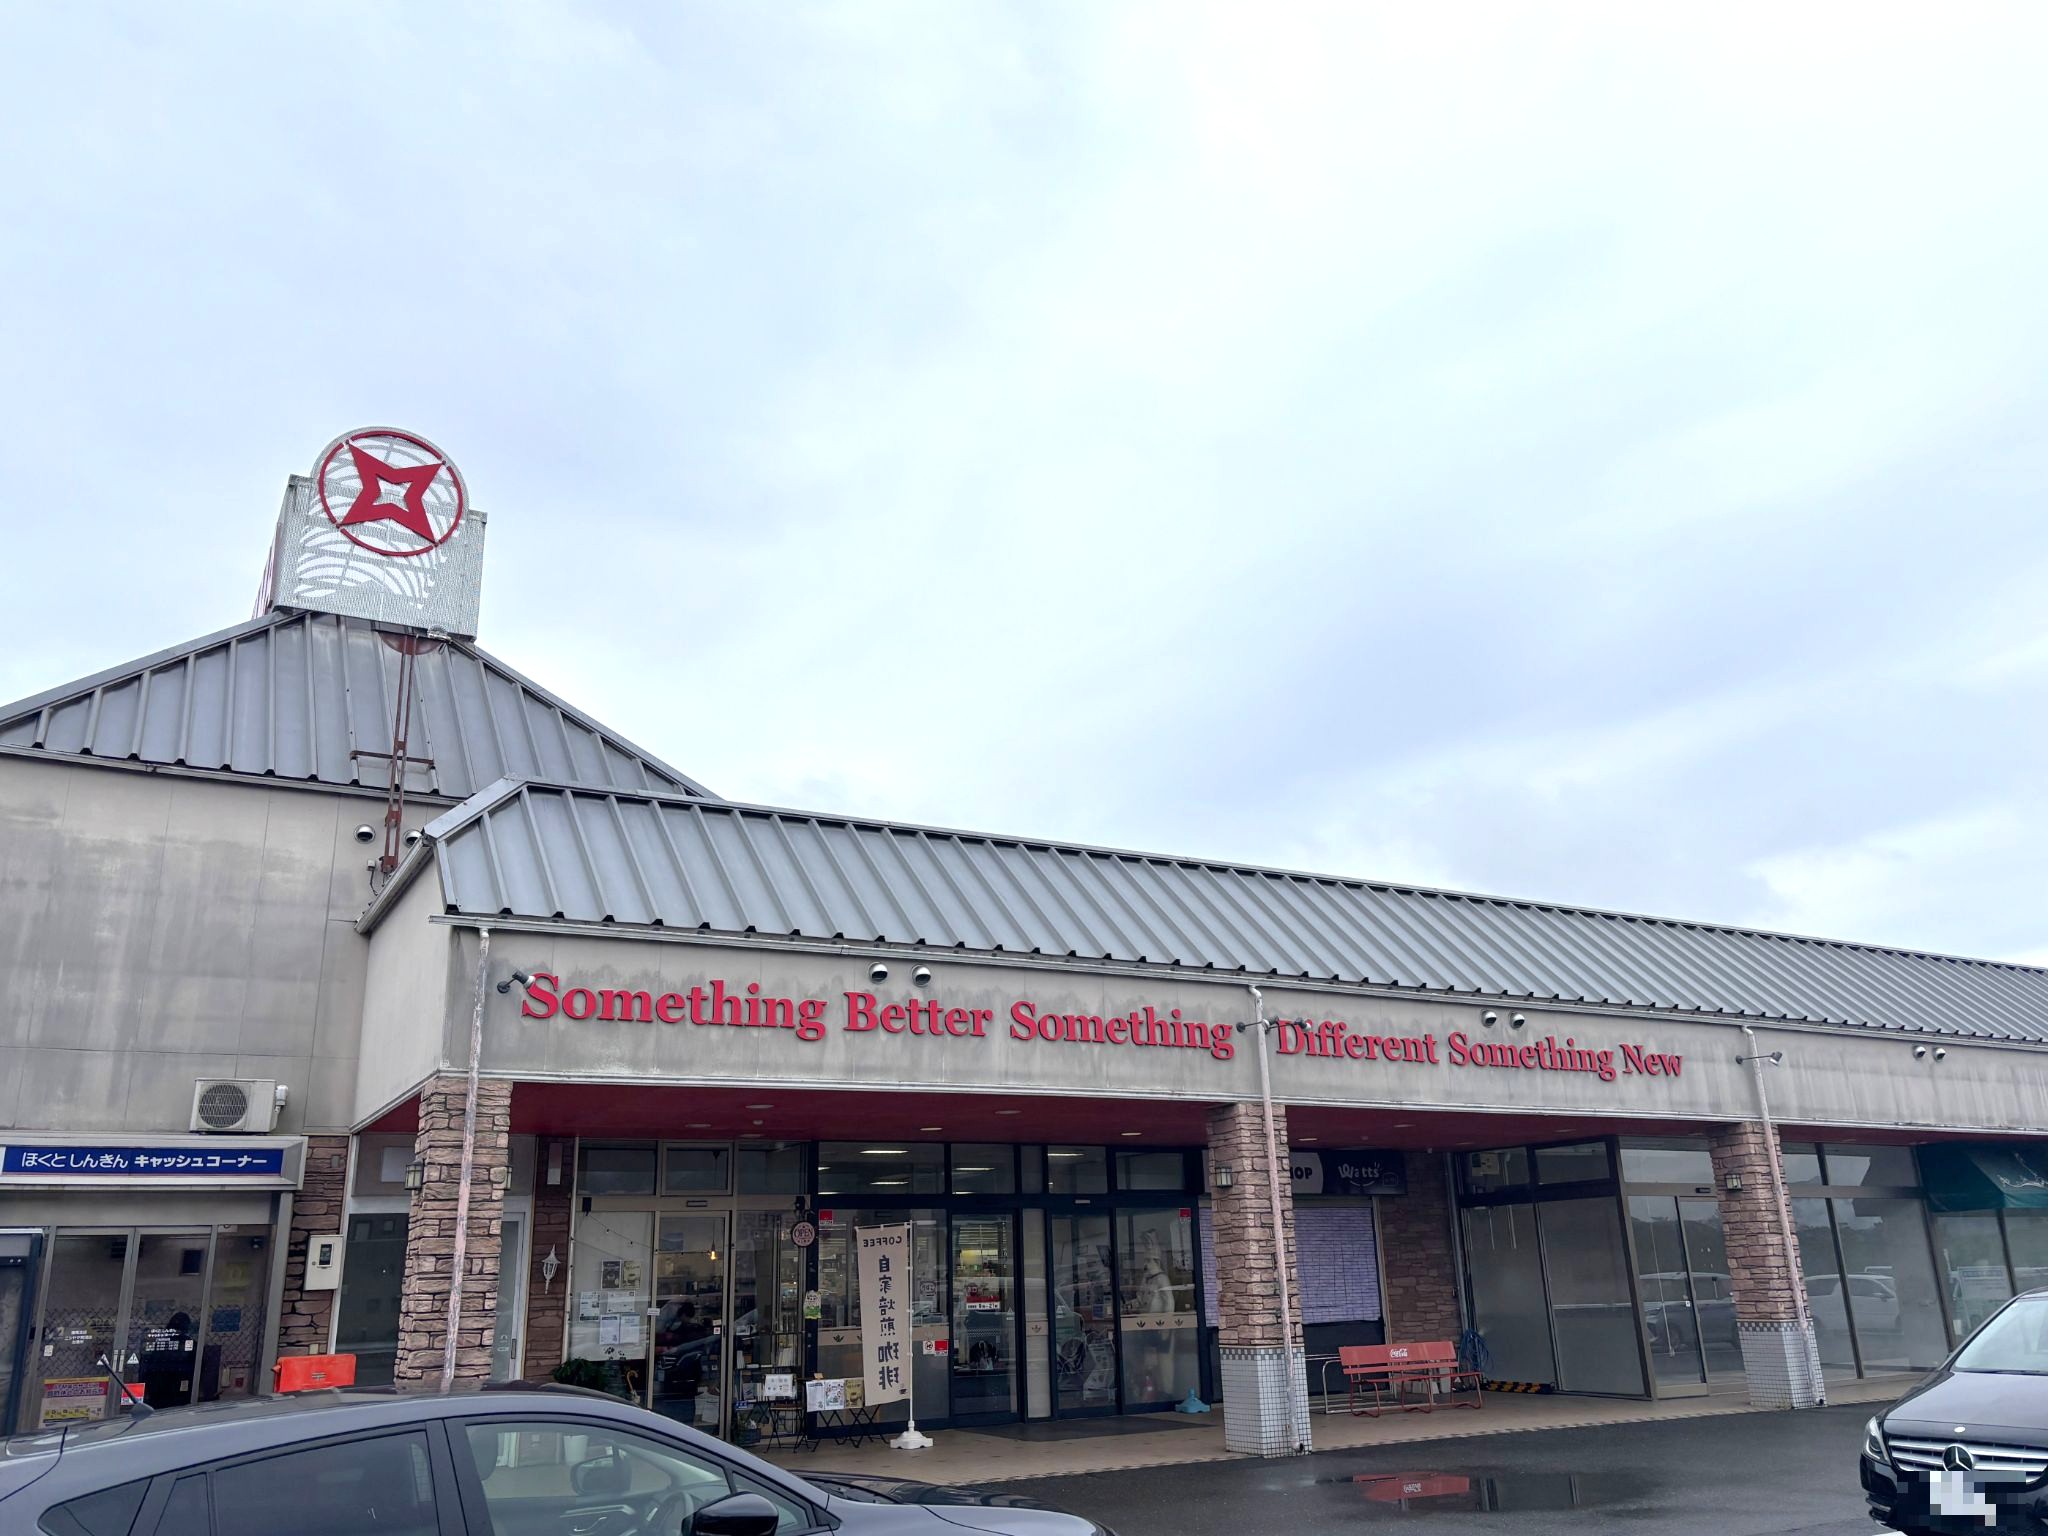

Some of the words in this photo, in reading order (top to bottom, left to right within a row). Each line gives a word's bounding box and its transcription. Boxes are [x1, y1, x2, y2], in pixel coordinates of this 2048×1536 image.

[522, 972, 828, 1041] Something
[843, 991, 993, 1037] Better
[1010, 1000, 1235, 1060] Something
[1276, 1018, 1440, 1065] Different
[1448, 1030, 1617, 1082] Something
[1619, 1042, 1684, 1078] New
[134, 1154, 268, 1168] キャッシュコーナー
